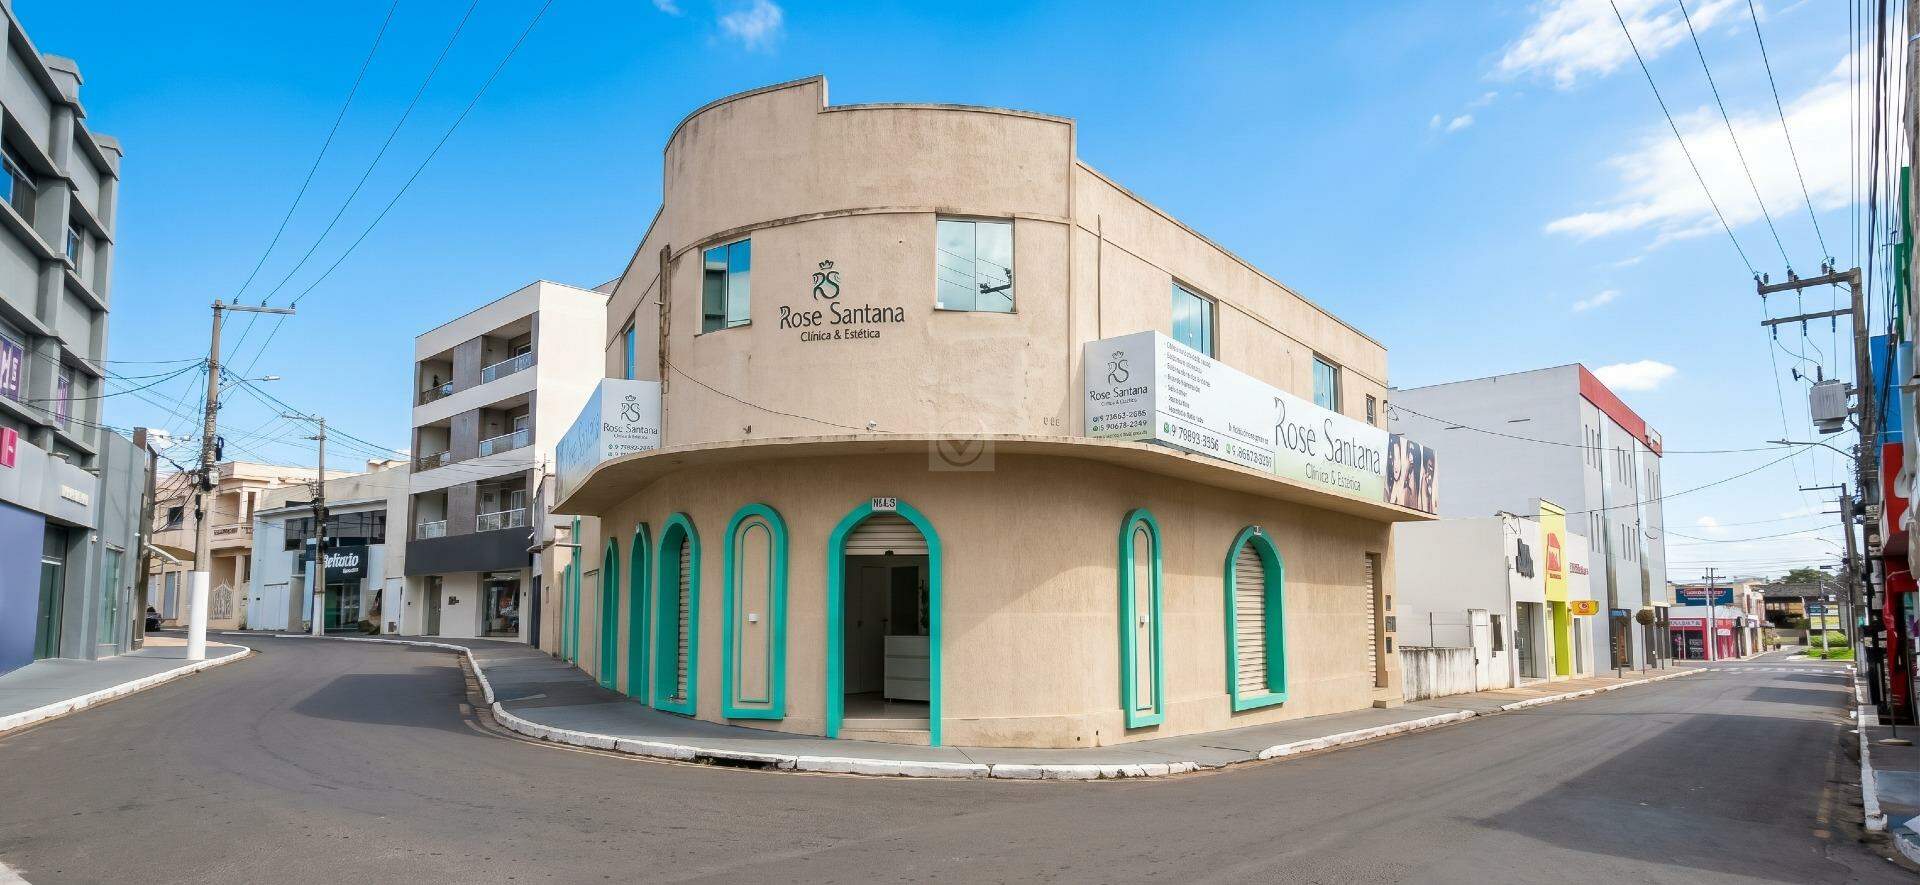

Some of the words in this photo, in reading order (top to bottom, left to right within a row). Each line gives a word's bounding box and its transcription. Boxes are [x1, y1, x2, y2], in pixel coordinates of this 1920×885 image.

[779, 305, 823, 330] Rose
[830, 301, 905, 326] Santana
[800, 330, 832, 342] Clínica
[834, 330, 842, 340] &
[844, 328, 881, 340] Estética
[1089, 390, 1111, 402] Rose
[1113, 385, 1148, 398] Santana
[603, 422, 623, 433] Rose
[625, 423, 658, 435] Santana
[1272, 396, 1317, 458] Rose
[1324, 417, 1382, 476] Santana
[1331, 470, 1336, 485] &
